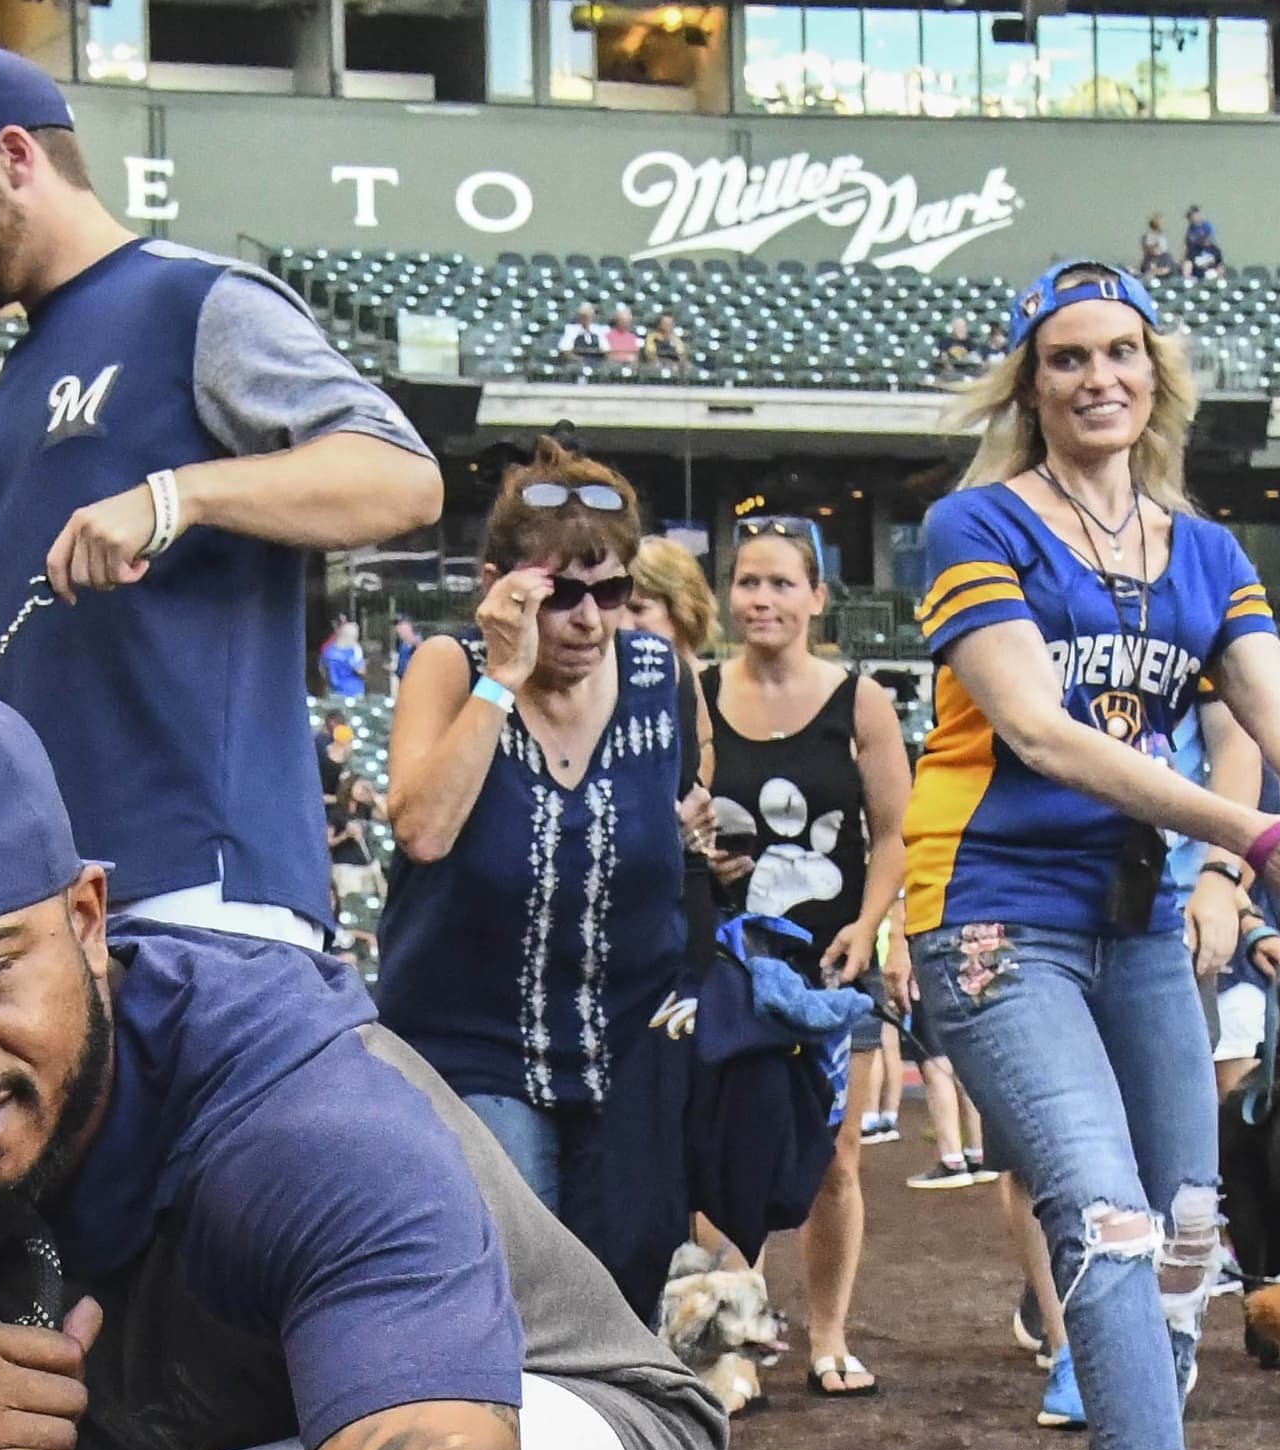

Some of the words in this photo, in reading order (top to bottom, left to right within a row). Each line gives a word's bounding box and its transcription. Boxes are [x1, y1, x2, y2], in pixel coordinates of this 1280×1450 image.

[331, 165, 533, 233] TO
[621, 150, 866, 258] Miller
[818, 165, 1017, 272] Park
